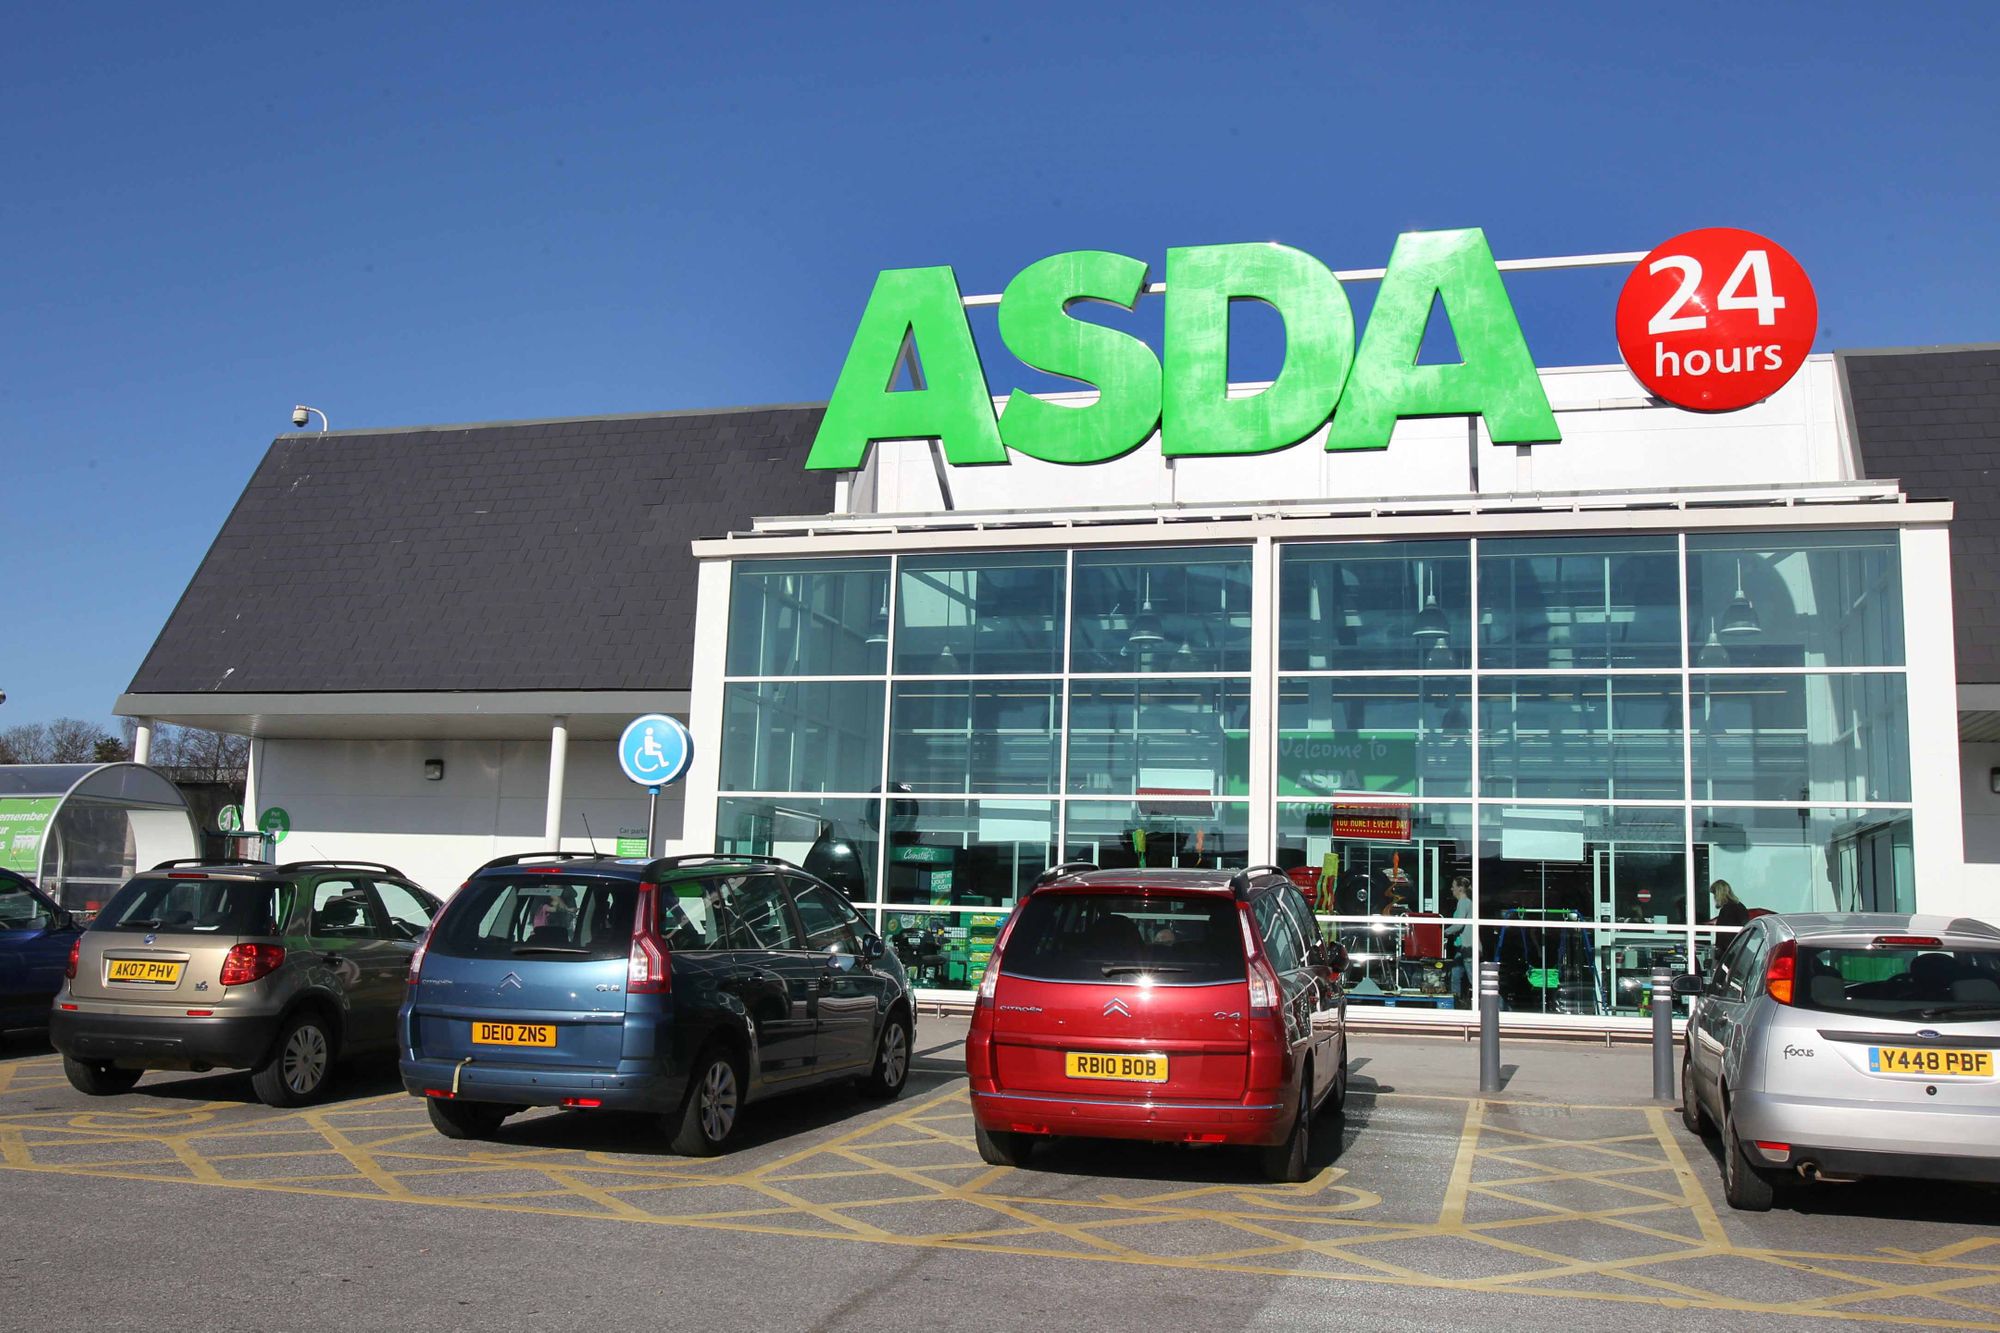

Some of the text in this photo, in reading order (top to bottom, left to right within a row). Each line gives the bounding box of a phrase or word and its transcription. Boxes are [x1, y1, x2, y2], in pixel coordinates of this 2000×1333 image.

[1648, 250, 1786, 335] 24
[805, 229, 1563, 471] ASDA
[1655, 342, 1783, 377] hours
[1368, 735, 1387, 760] to
[1295, 769, 1361, 789] ASDA
[0, 812, 48, 821] emember
[116, 963, 174, 978] AK07 PHV
[482, 1025, 547, 1043] DE10 ZNS
[1078, 1056, 1156, 1076] RB10 BOB
[1882, 1050, 1988, 1072] Y448 PBF
